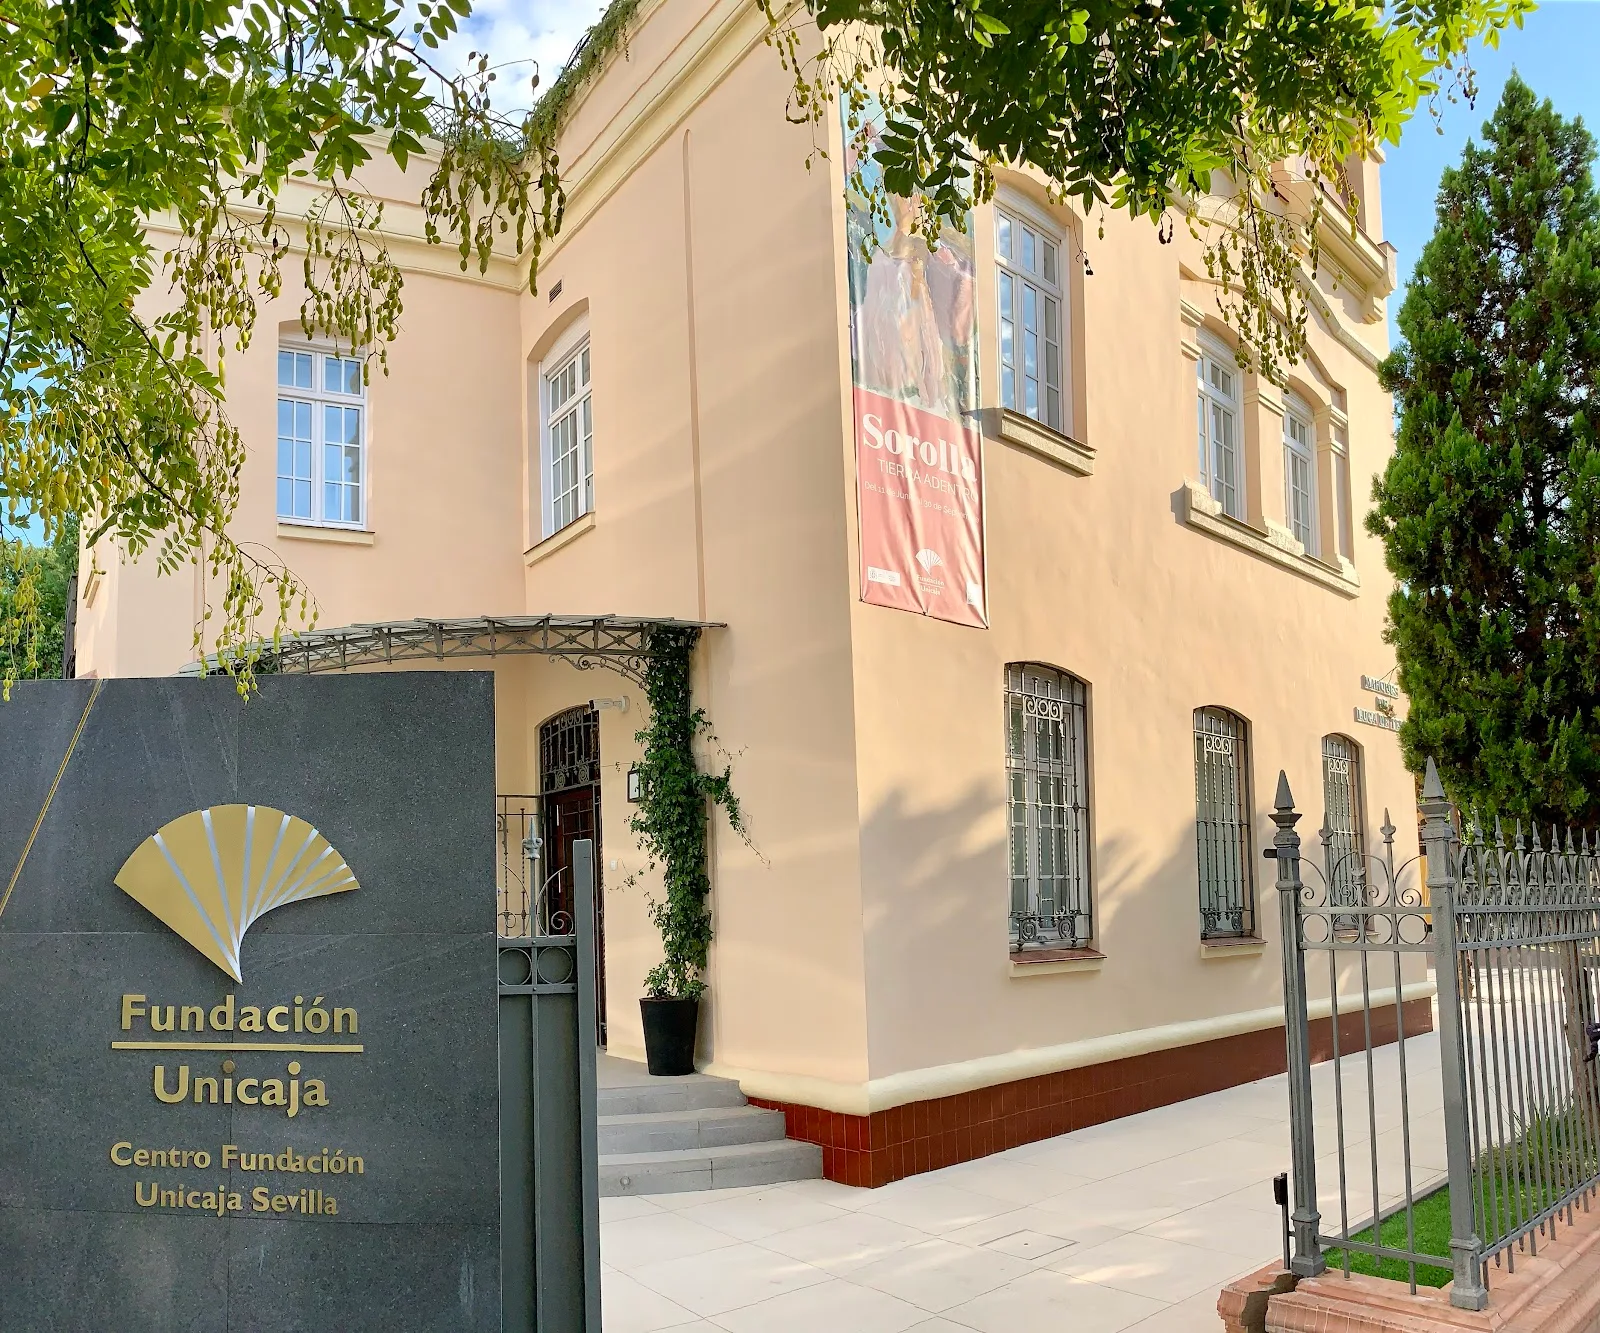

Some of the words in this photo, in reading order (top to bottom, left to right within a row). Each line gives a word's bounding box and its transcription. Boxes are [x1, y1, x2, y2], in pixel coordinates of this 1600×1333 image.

[862, 413, 977, 482] Sorolla
[896, 490, 916, 501] Juni
[934, 502, 942, 511] de
[121, 994, 358, 1034] Fundación
[153, 1059, 330, 1118] Unicaja
[110, 1141, 211, 1169] Centro
[221, 1144, 364, 1174] Fundación
[135, 1181, 243, 1218] Unicaja
[251, 1186, 339, 1215] Sevilla
